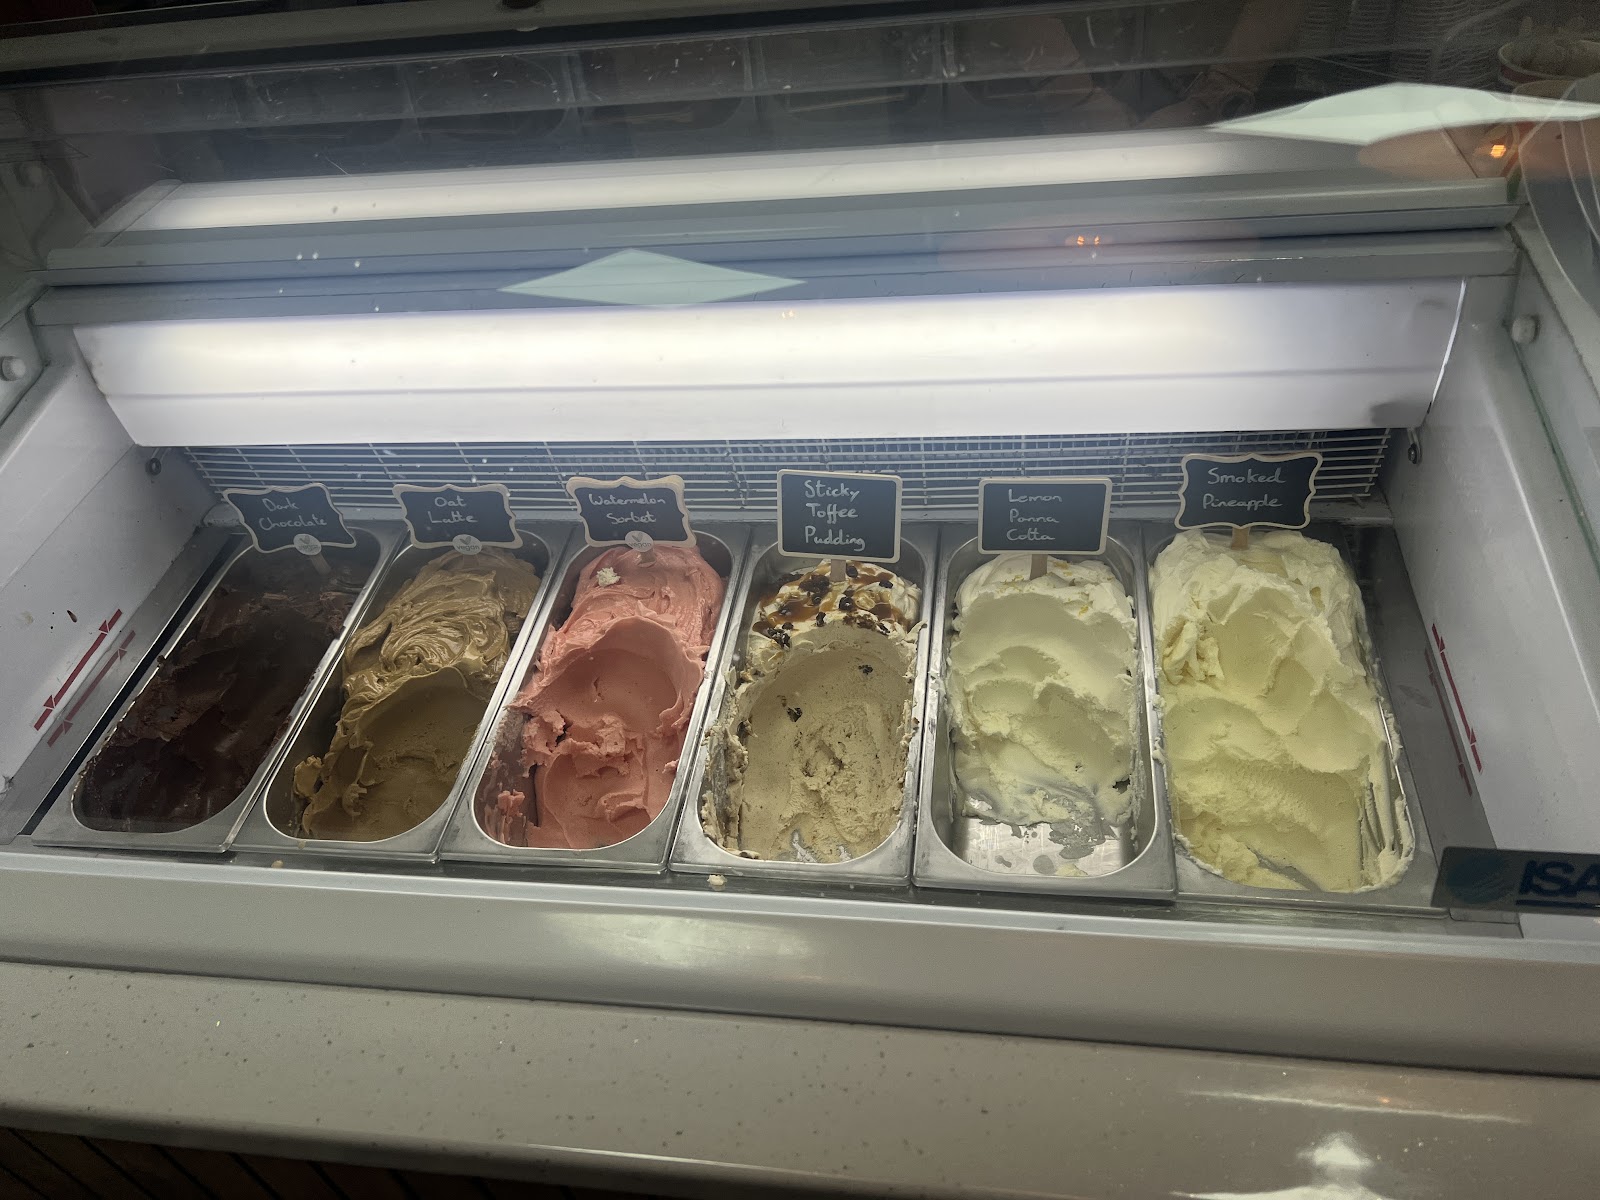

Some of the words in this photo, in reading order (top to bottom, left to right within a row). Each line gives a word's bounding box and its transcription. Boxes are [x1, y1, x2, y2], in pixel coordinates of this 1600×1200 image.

[1207, 467, 1287, 485] Smoked
[804, 479, 860, 502] Sticky
[1008, 488, 1063, 503] Lemon
[261, 497, 300, 511] Dark
[434, 495, 467, 507] Oat
[588, 493, 666, 506] Watermelon
[1202, 493, 1283, 511] Pineapple
[427, 511, 478, 523] Latte
[606, 511, 657, 525] Sorbet
[805, 502, 859, 525] Toffee
[1009, 508, 1060, 523] Panna
[259, 513, 328, 531] Chocolate
[804, 525, 866, 552] Pudding
[1006, 527, 1056, 541] Cotta
[457, 544, 480, 552] vegan
